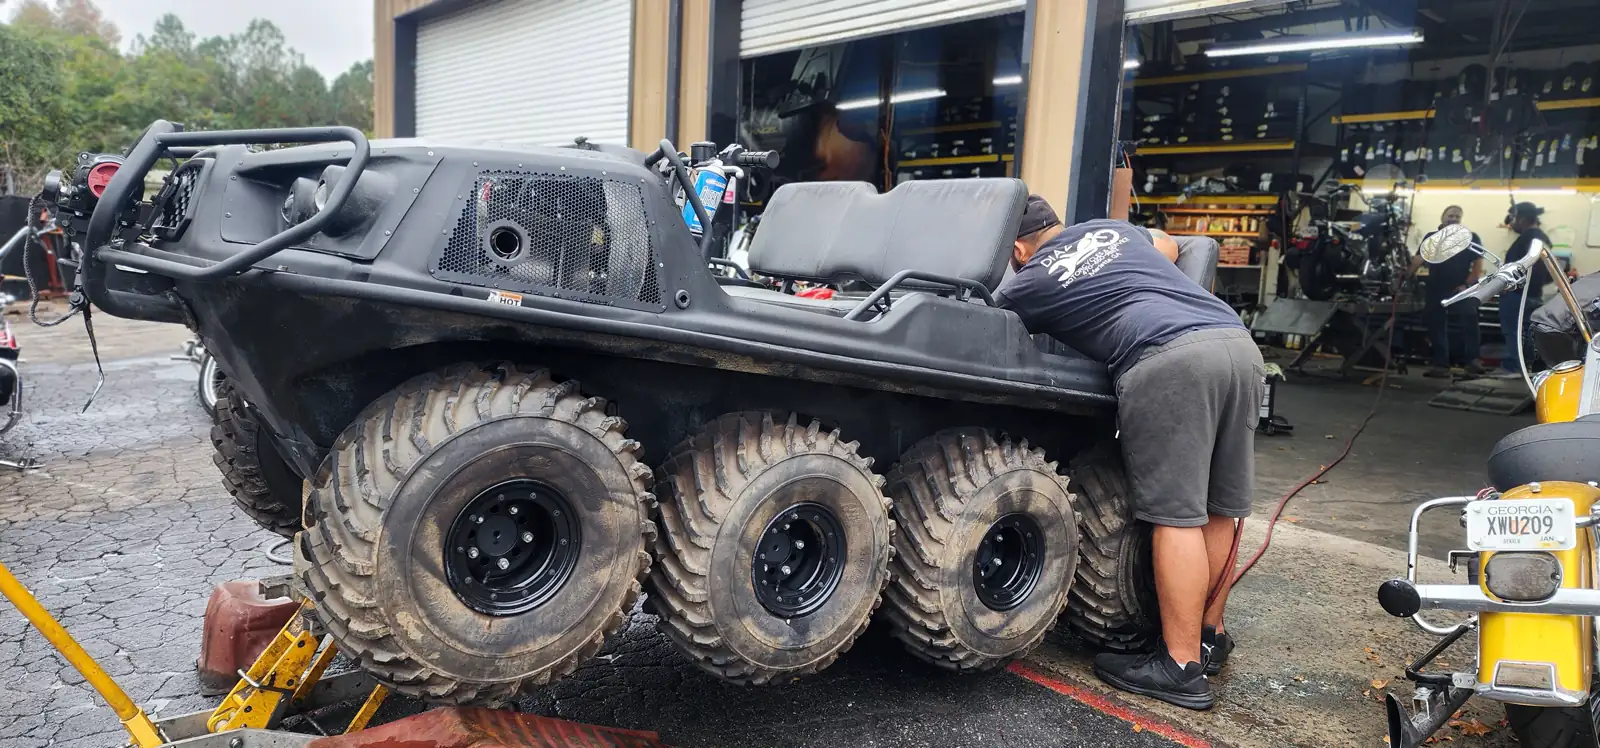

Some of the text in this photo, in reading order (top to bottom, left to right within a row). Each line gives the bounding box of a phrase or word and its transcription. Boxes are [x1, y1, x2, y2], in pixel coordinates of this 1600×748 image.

[500, 297, 520, 306] HOT
[1488, 505, 1553, 515] GEORGIA
[1487, 515, 1553, 535] XWU209
